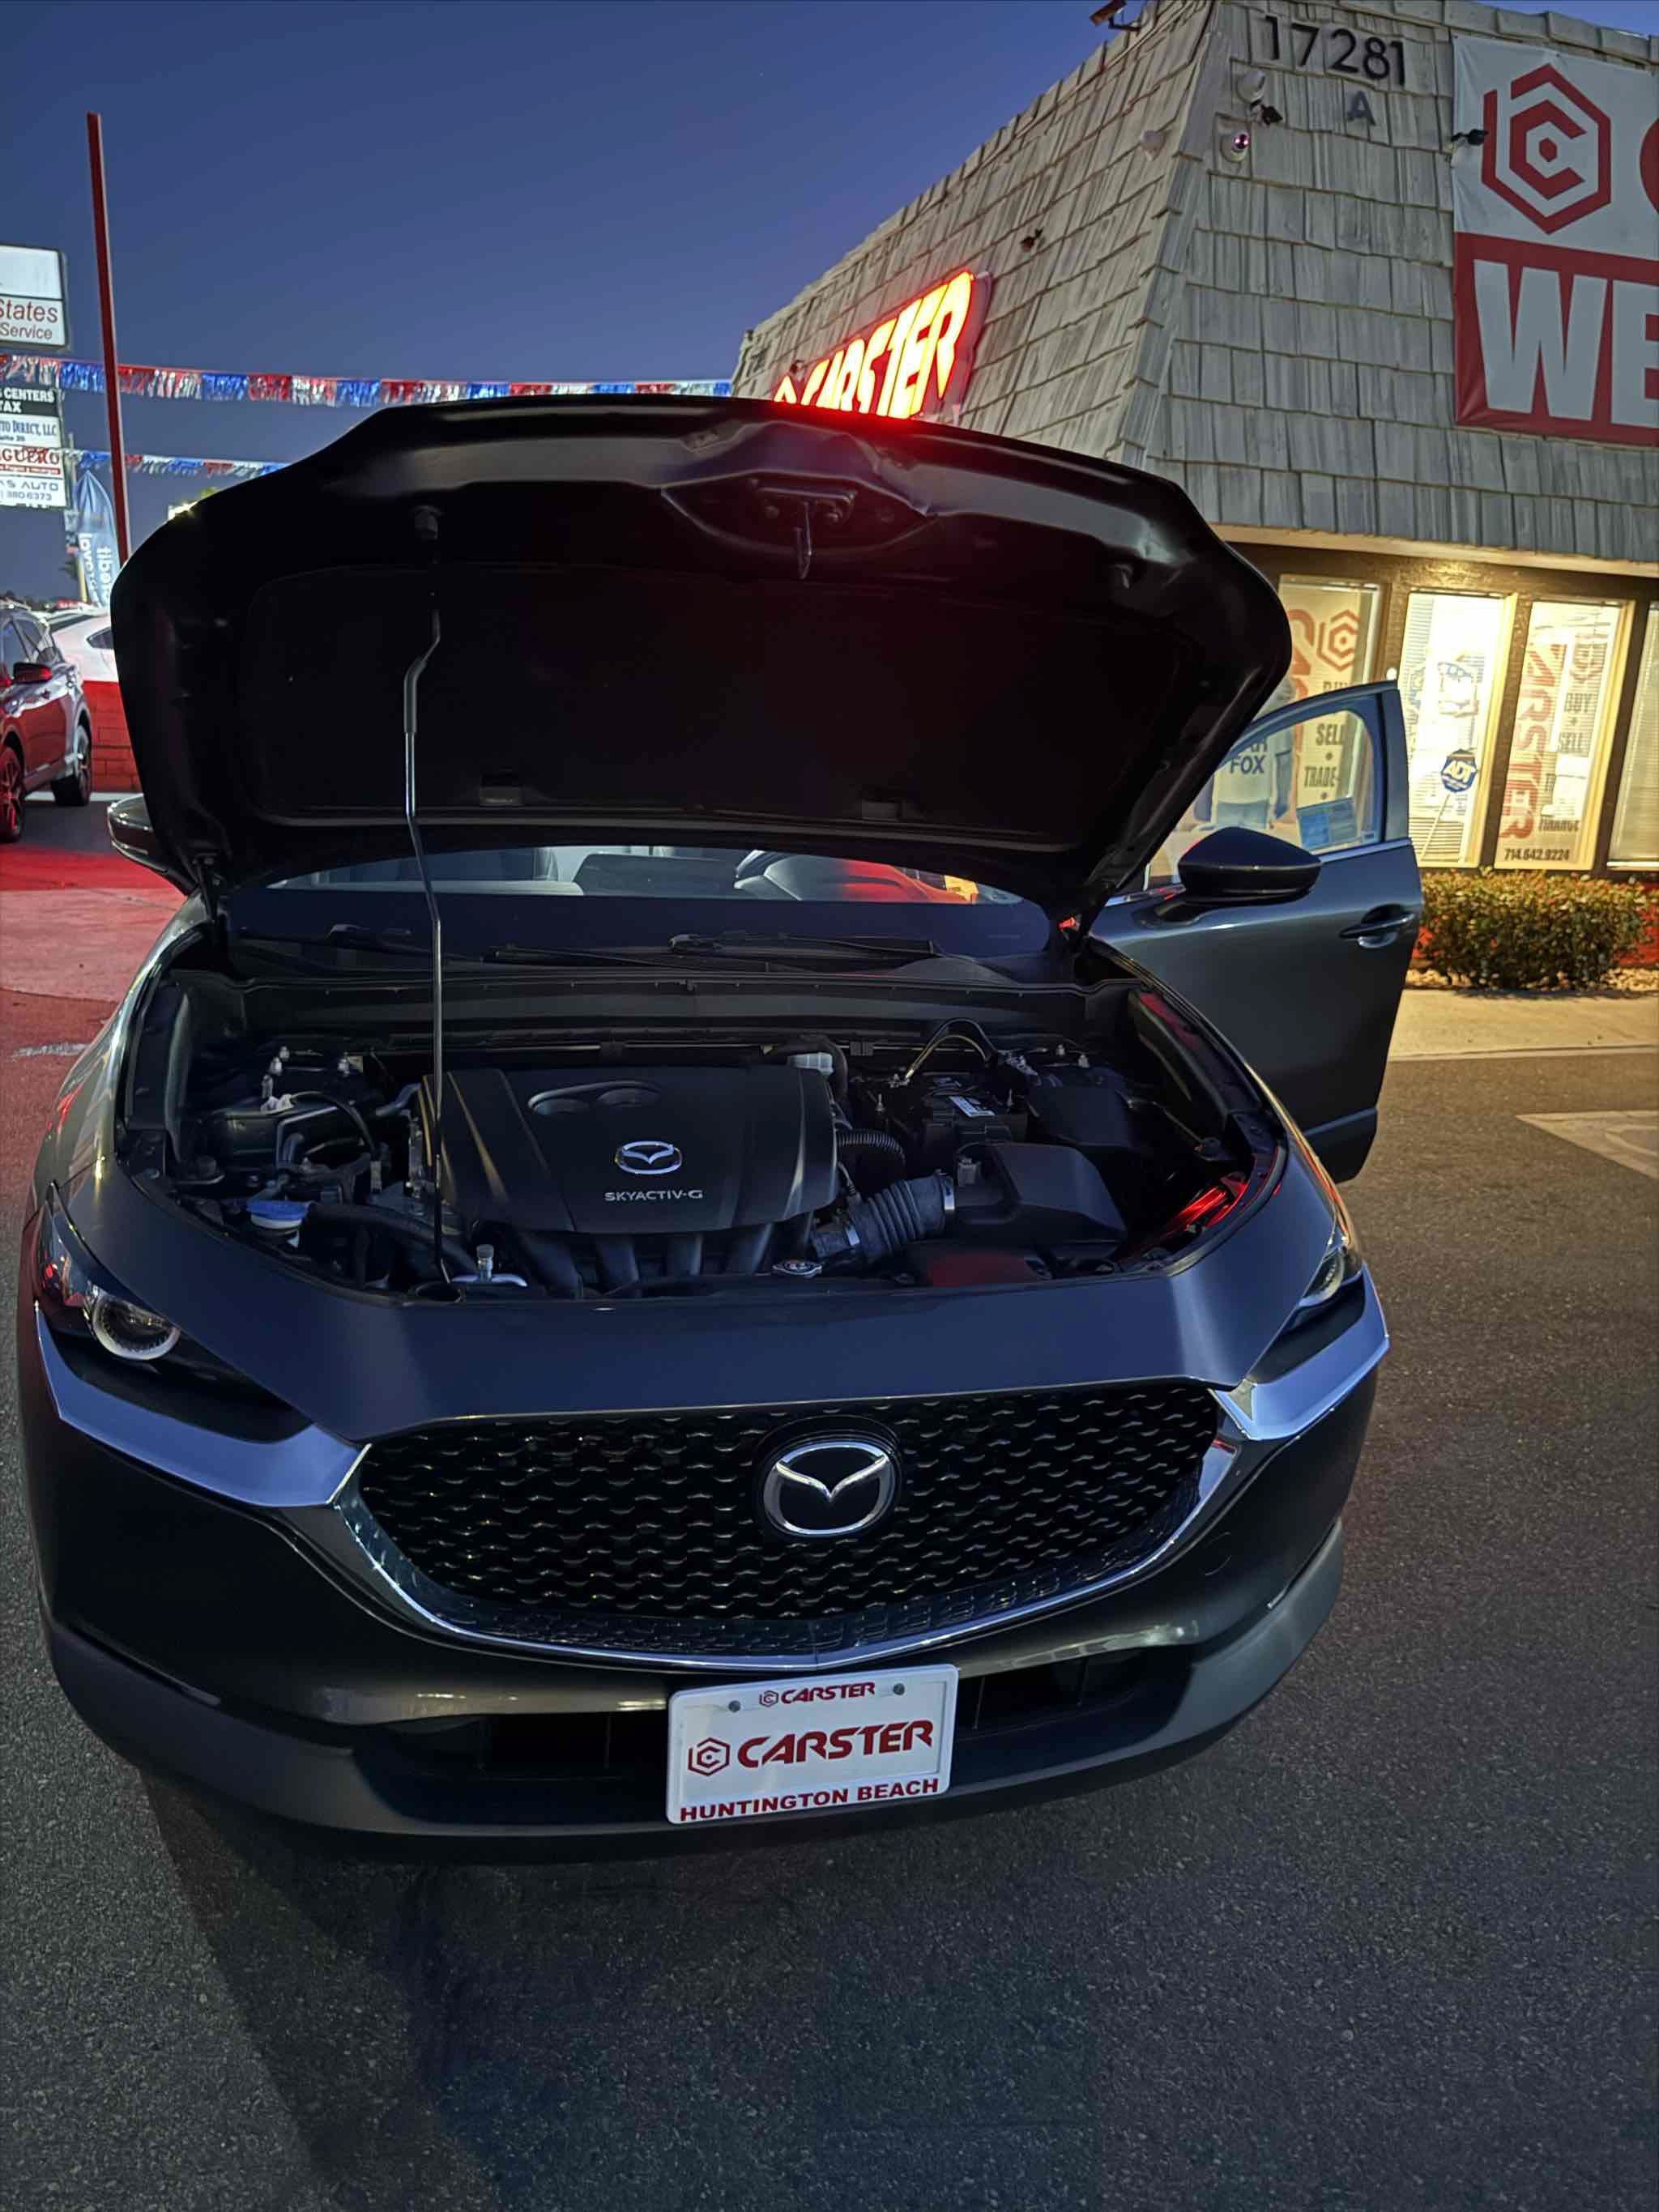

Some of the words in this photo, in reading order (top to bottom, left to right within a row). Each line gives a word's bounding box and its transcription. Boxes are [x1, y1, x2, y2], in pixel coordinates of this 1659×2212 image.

[1265, 15, 1406, 87] 17281
[1347, 90, 1376, 126] A
[0, 322, 53, 340] Service
[3, 387, 55, 403] CENTERS
[1499, 644, 1567, 838] ARSTER
[1230, 755, 1266, 775] FOX
[1443, 760, 1477, 783] ADT
[604, 1190, 703, 1201] SKYACTIV-G
[781, 1681, 876, 1704] CARSTER
[737, 1720, 934, 1768] CARSTER
[680, 1788, 849, 1822] HUNTINGTON
[857, 1778, 939, 1801] BEACH
